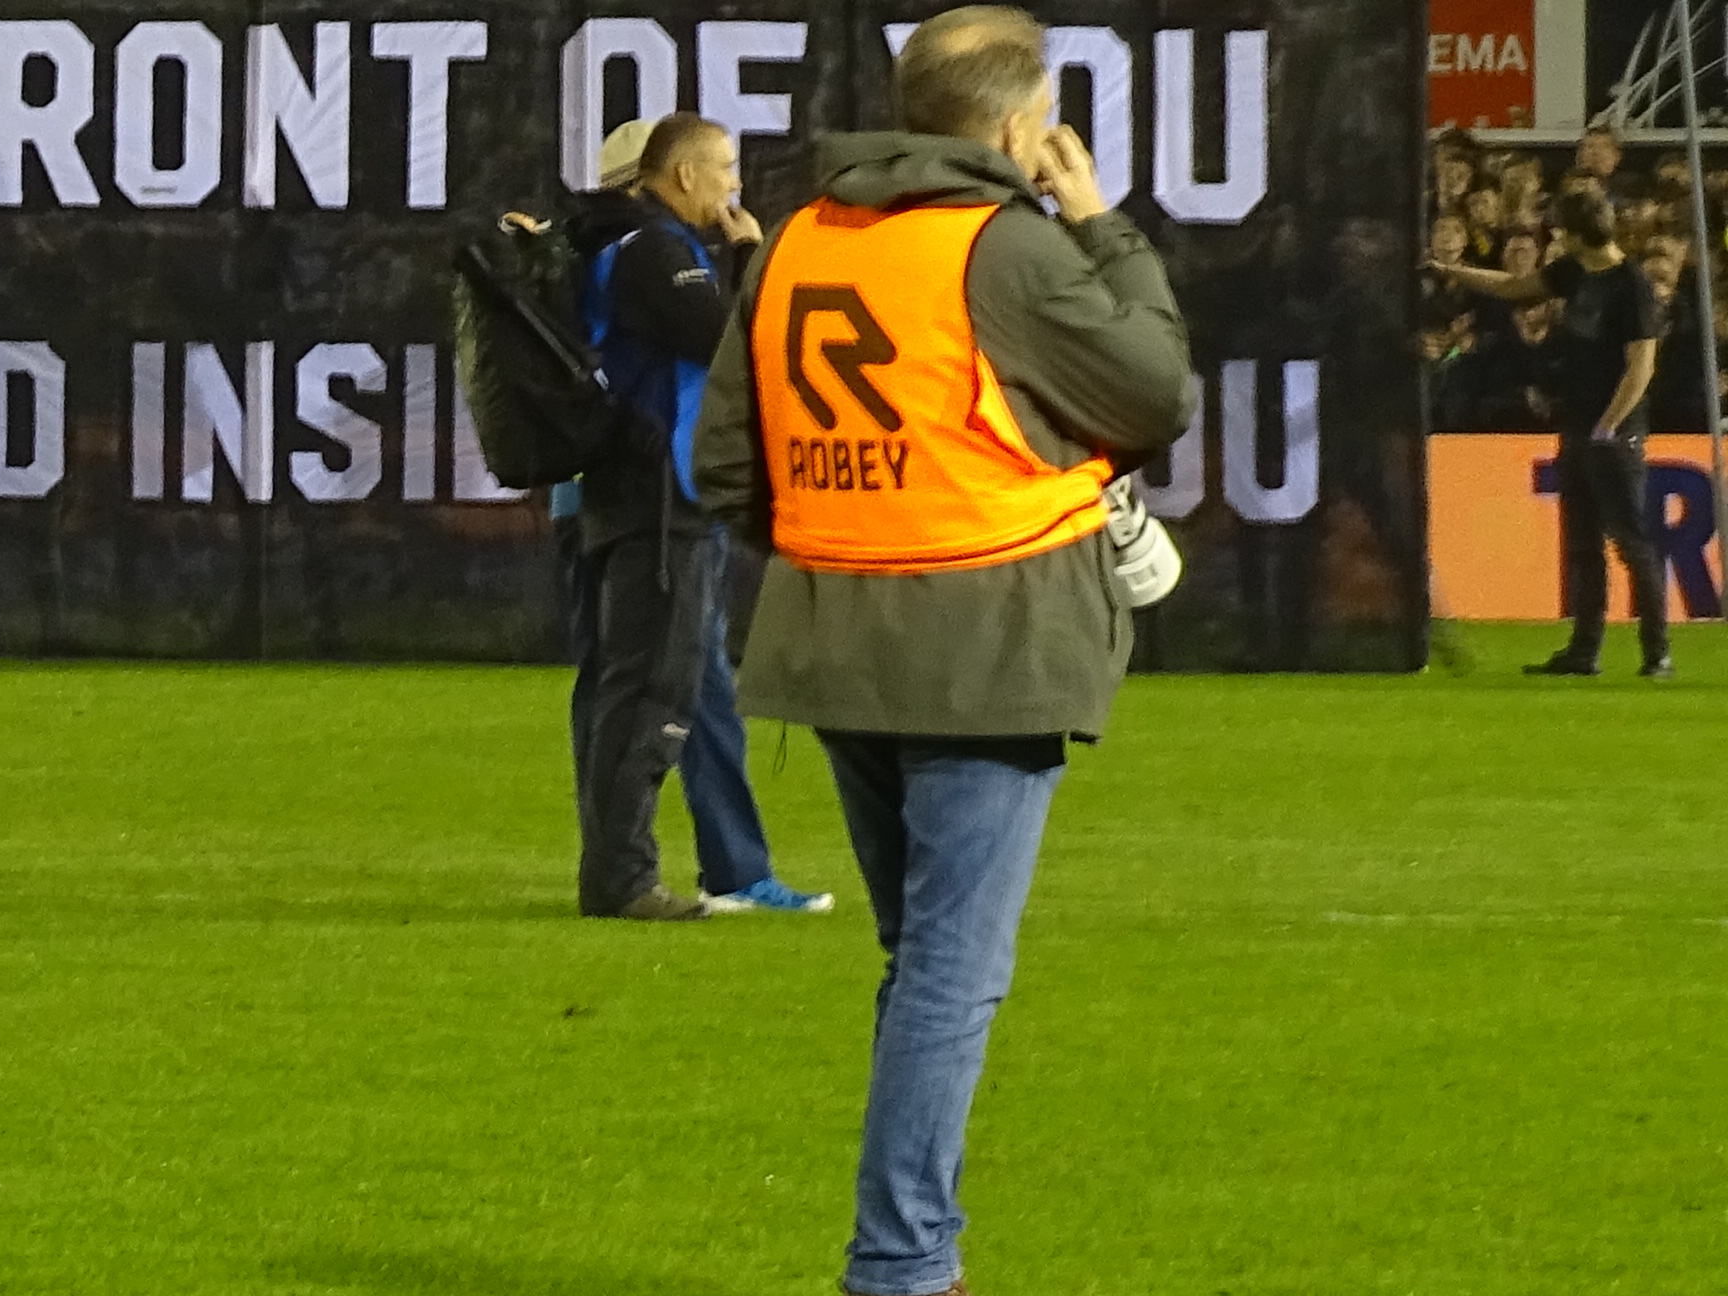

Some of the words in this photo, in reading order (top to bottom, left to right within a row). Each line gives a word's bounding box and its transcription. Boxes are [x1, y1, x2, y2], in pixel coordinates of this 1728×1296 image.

[560, 17, 808, 192] OF
[883, 22, 1269, 225] OU
[786, 282, 904, 433] R
[789, 436, 909, 492] ROBEY
